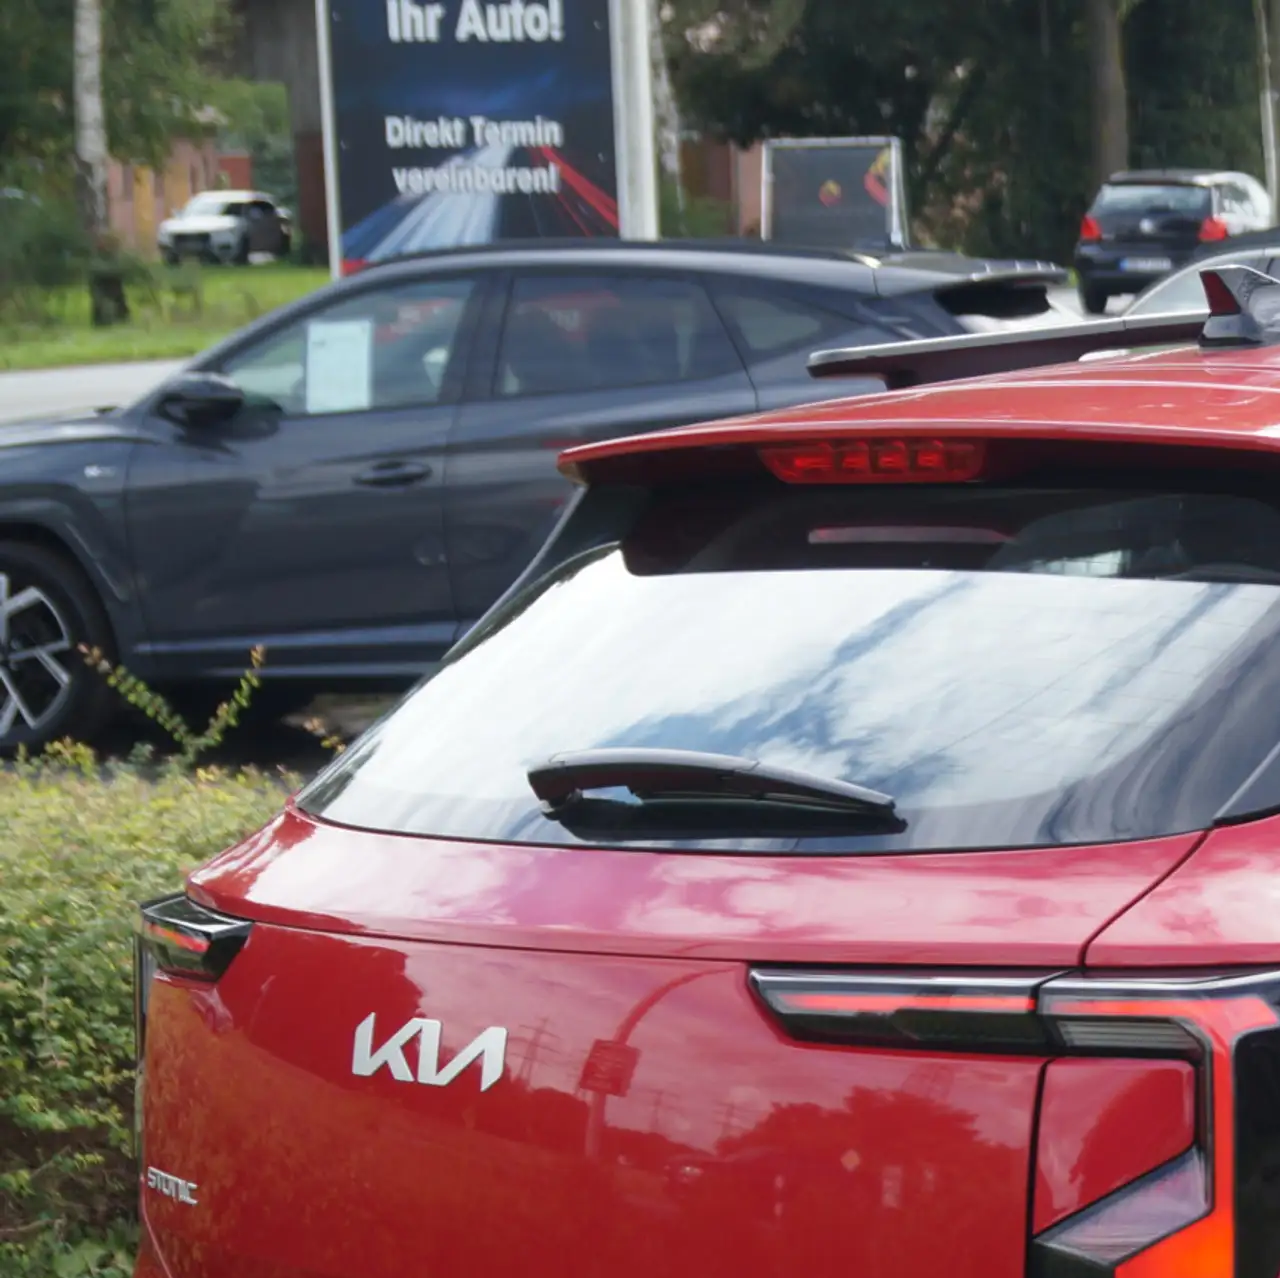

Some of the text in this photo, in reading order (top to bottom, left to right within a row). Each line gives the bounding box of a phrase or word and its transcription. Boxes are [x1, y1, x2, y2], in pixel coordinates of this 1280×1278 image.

[386, 0, 565, 42] Ihr Auto!
[384, 114, 564, 149] Direkt Termin
[392, 160, 561, 195] vereinbaren!
[352, 1011, 507, 1093] KIA
[147, 1165, 198, 1205] STONIC
